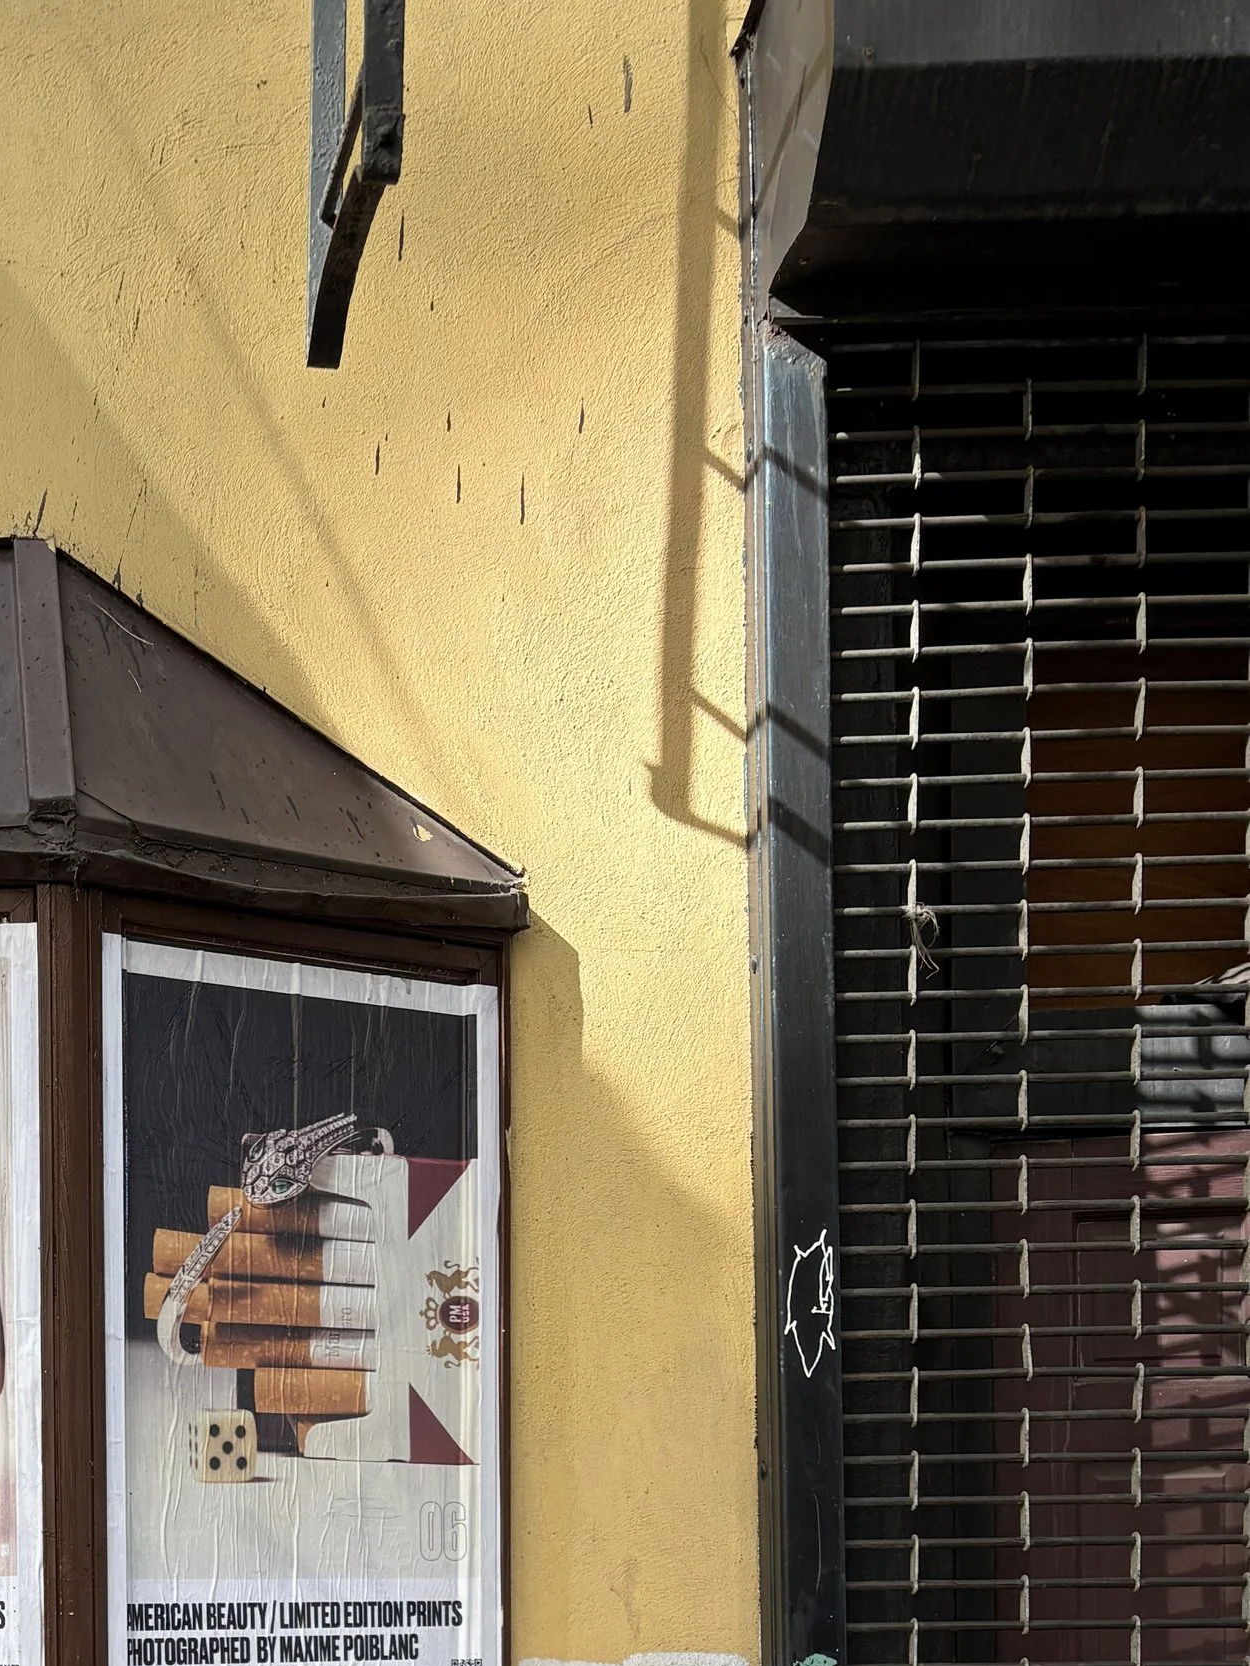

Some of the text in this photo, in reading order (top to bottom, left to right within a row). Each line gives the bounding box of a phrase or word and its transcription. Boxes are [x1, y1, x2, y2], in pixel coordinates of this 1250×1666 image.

[450, 1305, 462, 1323] PM
[462, 1304, 470, 1323] USA
[420, 1501, 468, 1561] 06
[207, 1602, 267, 1630] BEAUTY
[270, 1600, 276, 1633] /
[279, 1601, 341, 1630] LIMITED
[344, 1601, 403, 1628] EDITION
[407, 1600, 463, 1627] PRINTS
[128, 1634, 419, 1666] PHOTOGRAPHED BY MAXIME POIBLANC
